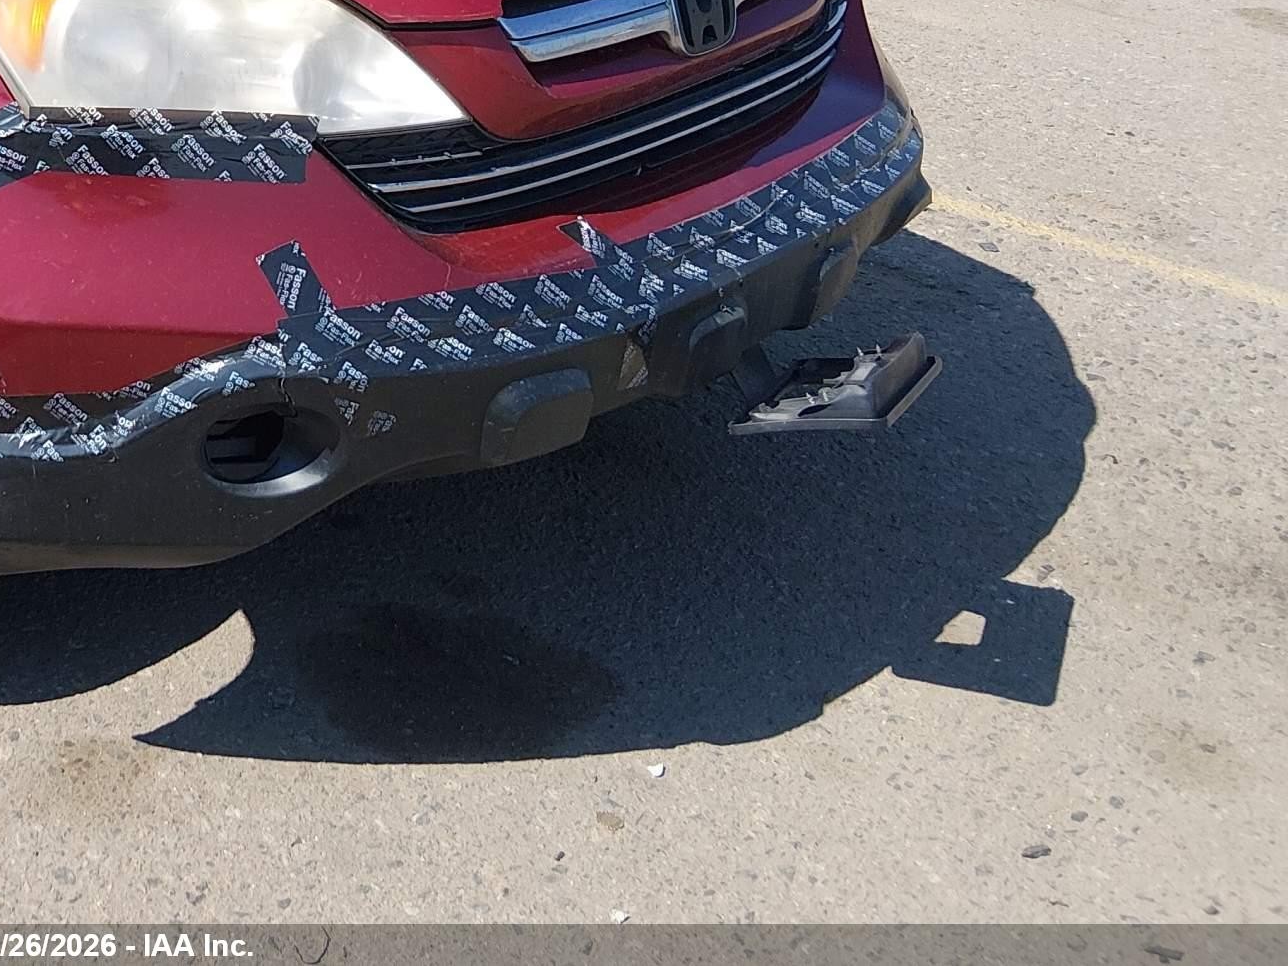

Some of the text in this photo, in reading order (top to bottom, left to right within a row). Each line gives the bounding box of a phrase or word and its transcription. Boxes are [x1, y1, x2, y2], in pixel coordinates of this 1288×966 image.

[183, 134, 215, 166] Fasson
[183, 145, 207, 172] Fas-Flex
[254, 144, 287, 179] Fasson
[287, 267, 307, 310] Fasson
[539, 274, 570, 304] Fasson
[591, 274, 624, 304] Fasson
[324, 306, 363, 340] Fasson
[326, 323, 356, 347] Fas-Flex
[53, 393, 87, 422] Fasson
